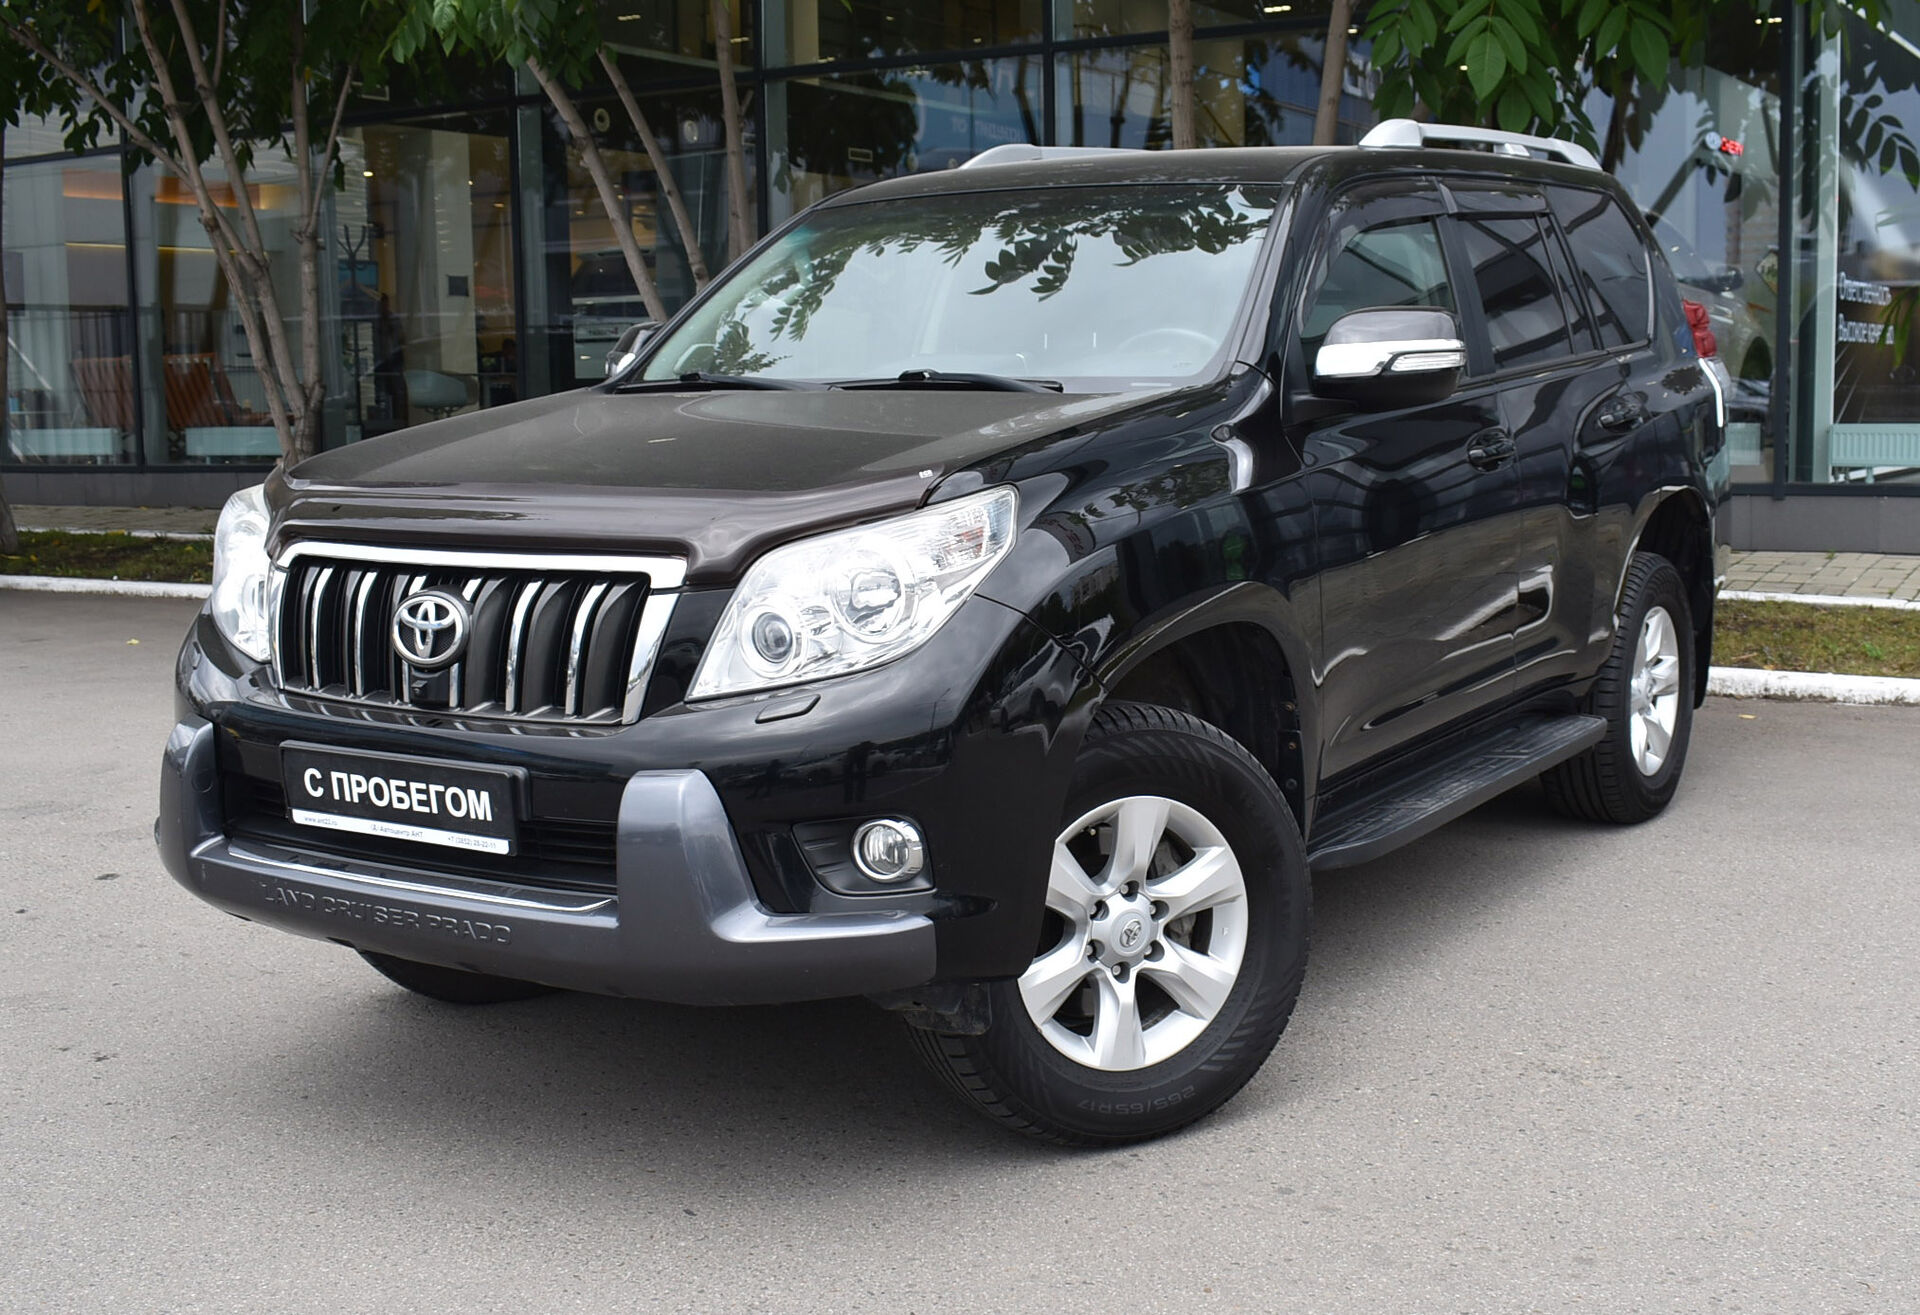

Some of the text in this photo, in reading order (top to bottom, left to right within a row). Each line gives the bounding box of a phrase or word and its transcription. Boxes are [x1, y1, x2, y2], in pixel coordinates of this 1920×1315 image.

[303, 767, 493, 822] С ПРОБЕГОМ
[262, 884, 512, 944] LAND CRUISER PRADO
[1077, 1084, 1197, 1116] 265/65R17
